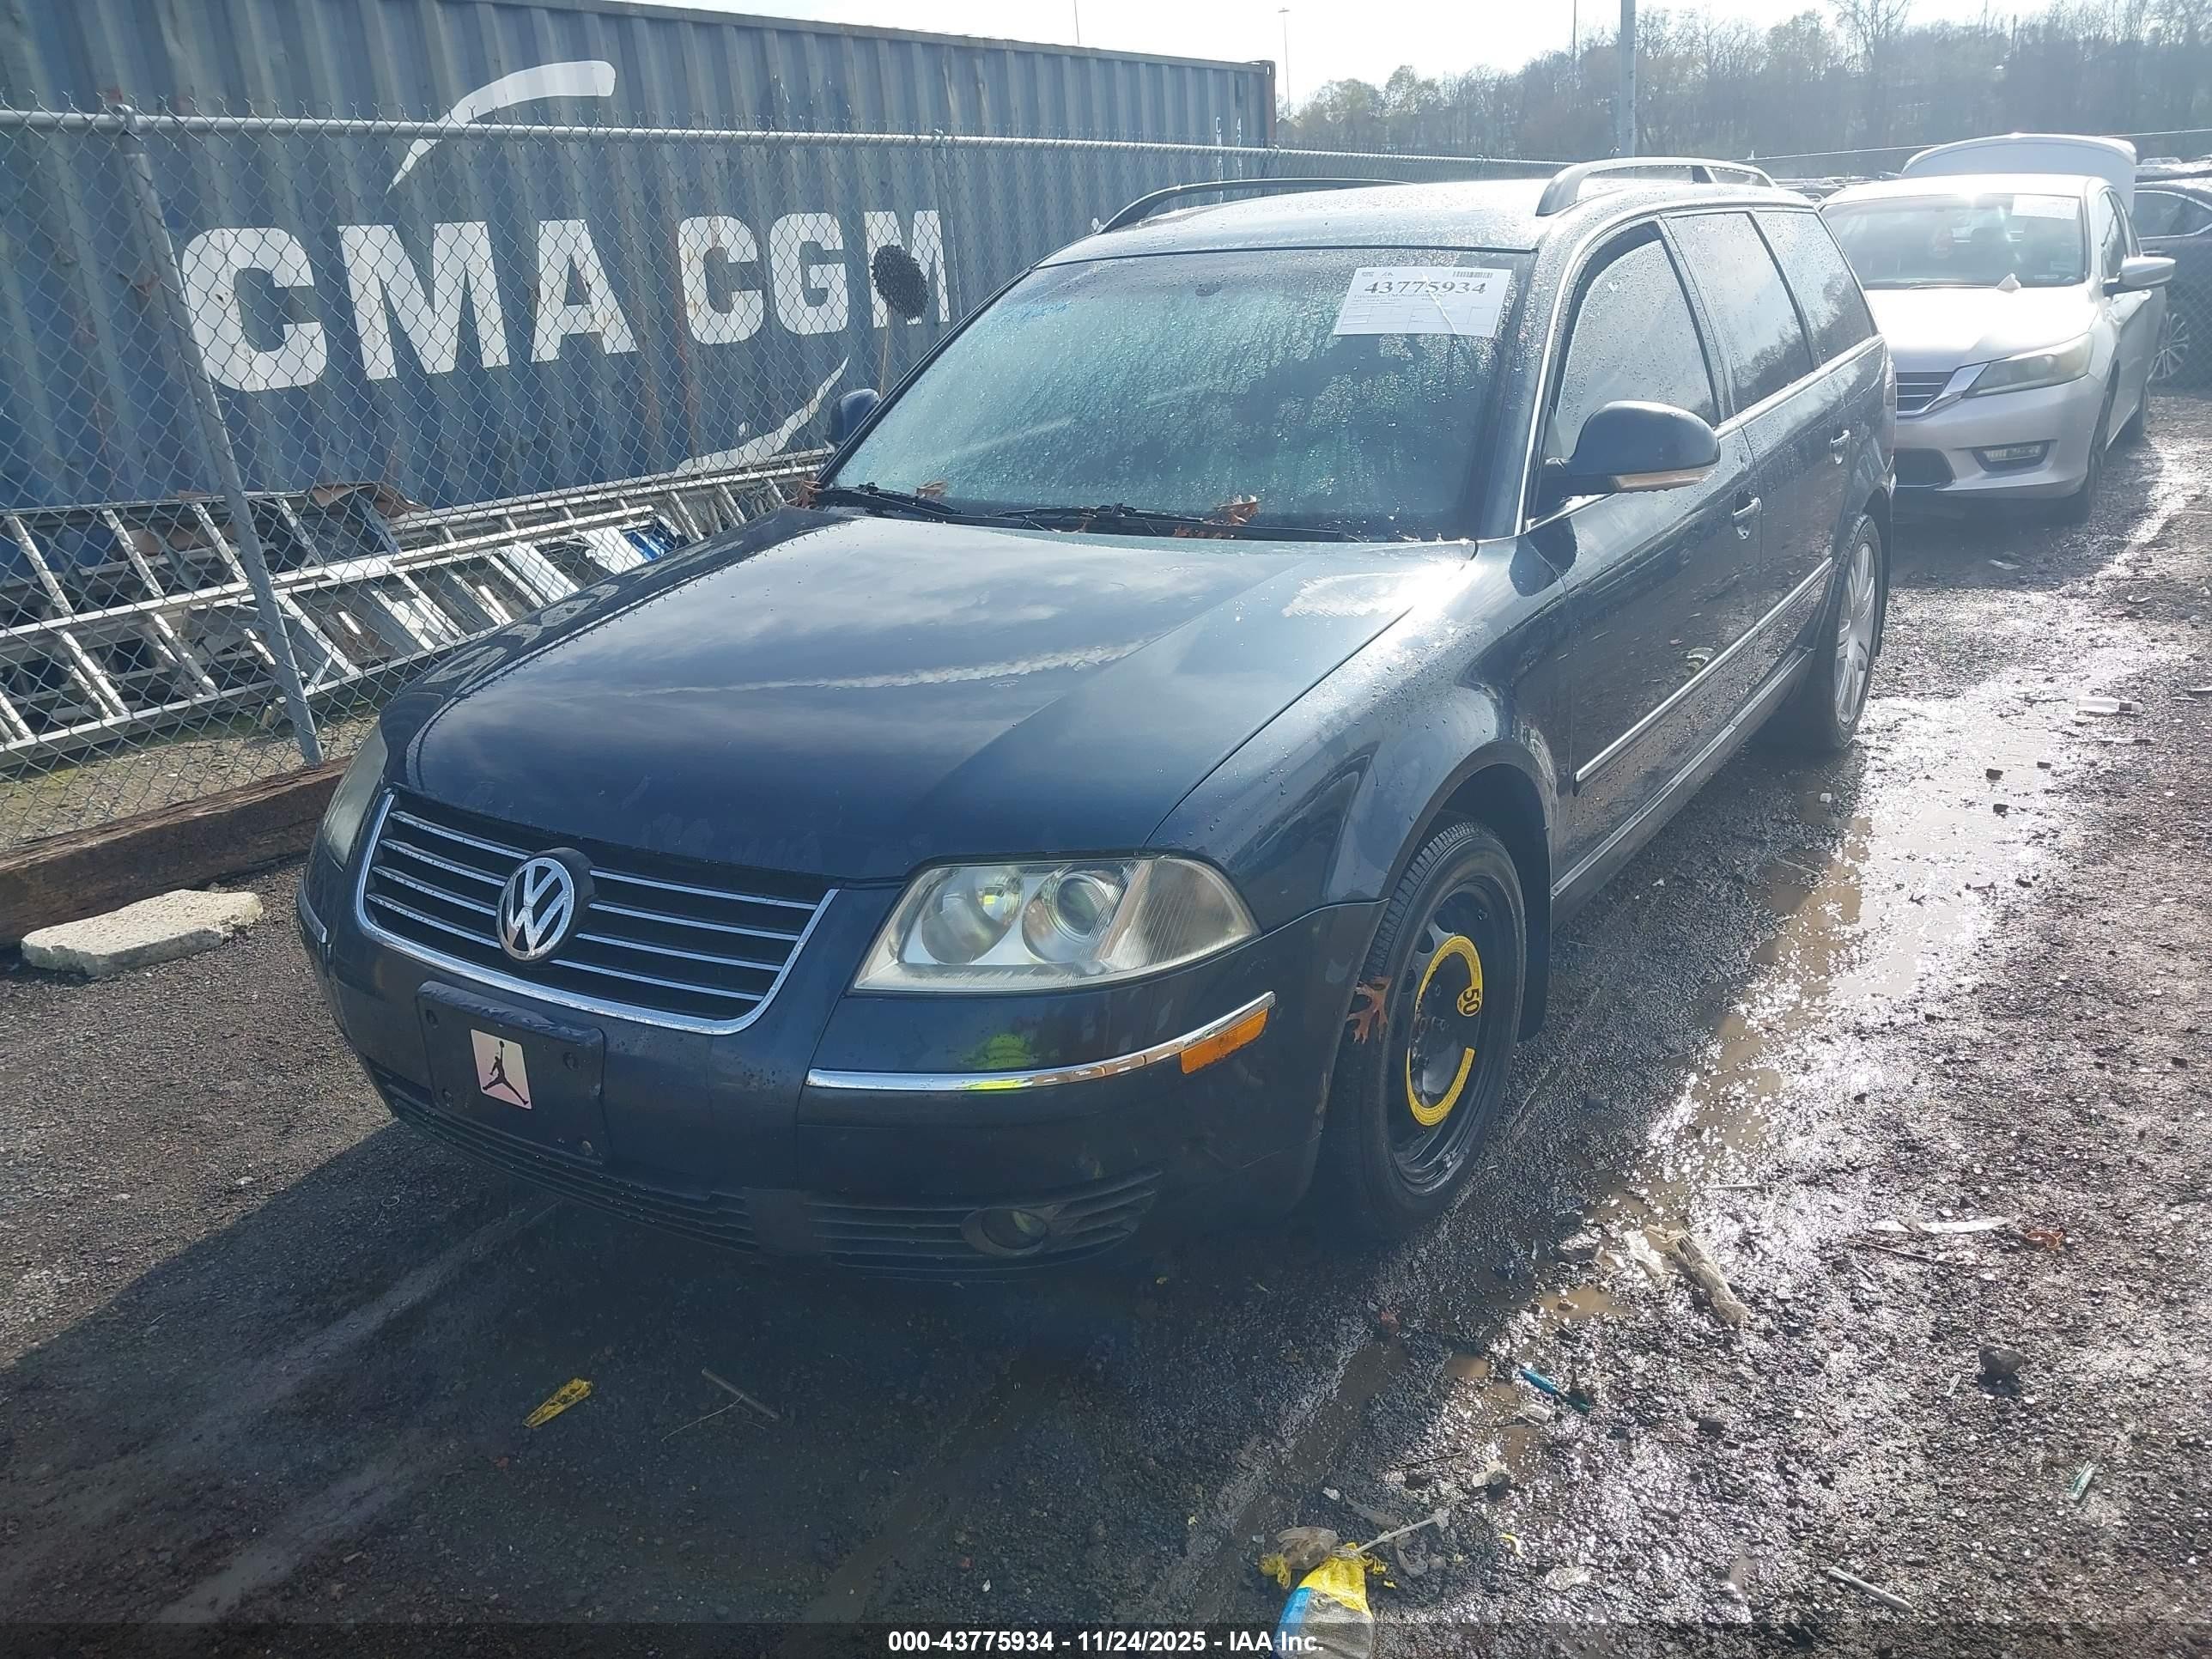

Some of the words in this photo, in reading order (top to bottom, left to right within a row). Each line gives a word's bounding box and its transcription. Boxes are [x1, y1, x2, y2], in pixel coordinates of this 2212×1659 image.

[182, 219, 638, 392] CMA
[678, 210, 950, 346] CGM
[1364, 281, 1486, 294] 43775934
[1462, 988, 1480, 1015] 50
